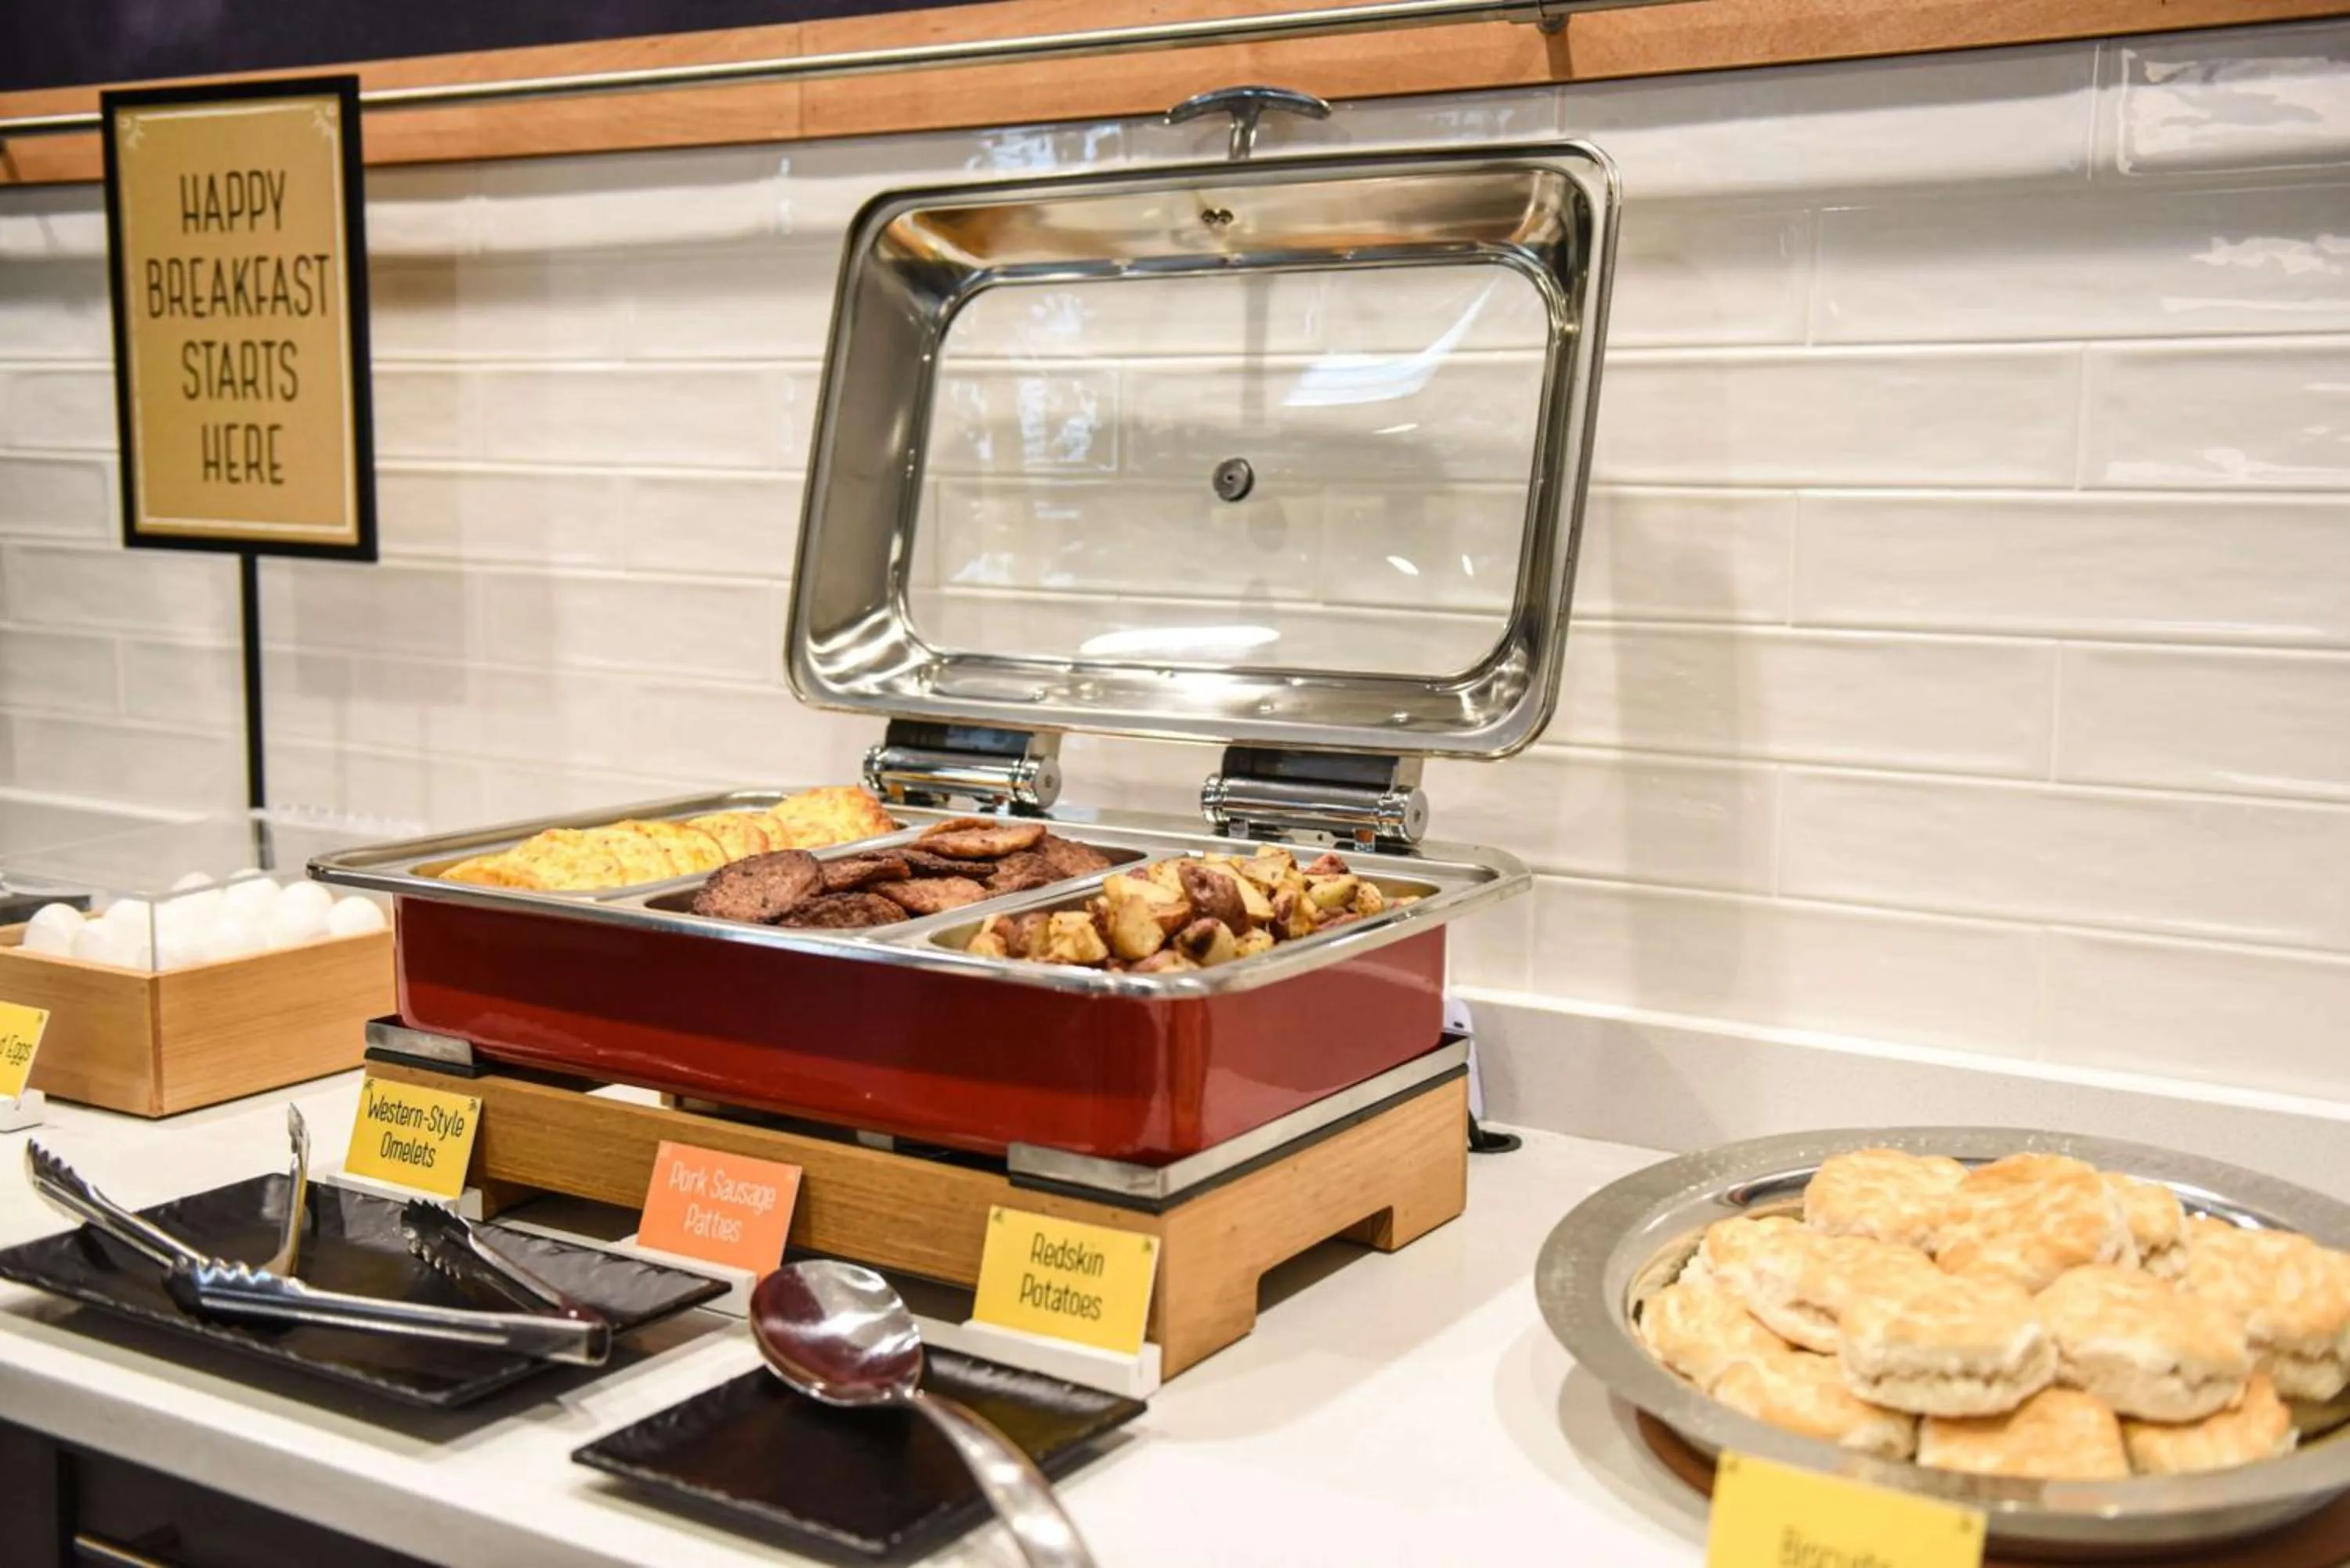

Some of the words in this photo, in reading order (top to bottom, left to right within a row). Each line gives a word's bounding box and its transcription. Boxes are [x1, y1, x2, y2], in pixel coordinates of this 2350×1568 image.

[180, 169, 285, 233] HAPPY
[146, 255, 330, 319] BREAKFAST
[182, 340, 299, 402] STARTS
[202, 424, 284, 486] HERE
[6, 1034, 33, 1066] Eggs
[367, 1093, 465, 1140] Western-Style
[380, 1131, 436, 1168] Omelets
[669, 1160, 708, 1194] Pork
[710, 1168, 776, 1216] Sausage
[683, 1202, 743, 1242] Patties
[1030, 1232, 1104, 1276] Redskin
[1019, 1273, 1102, 1321] Potatoes
